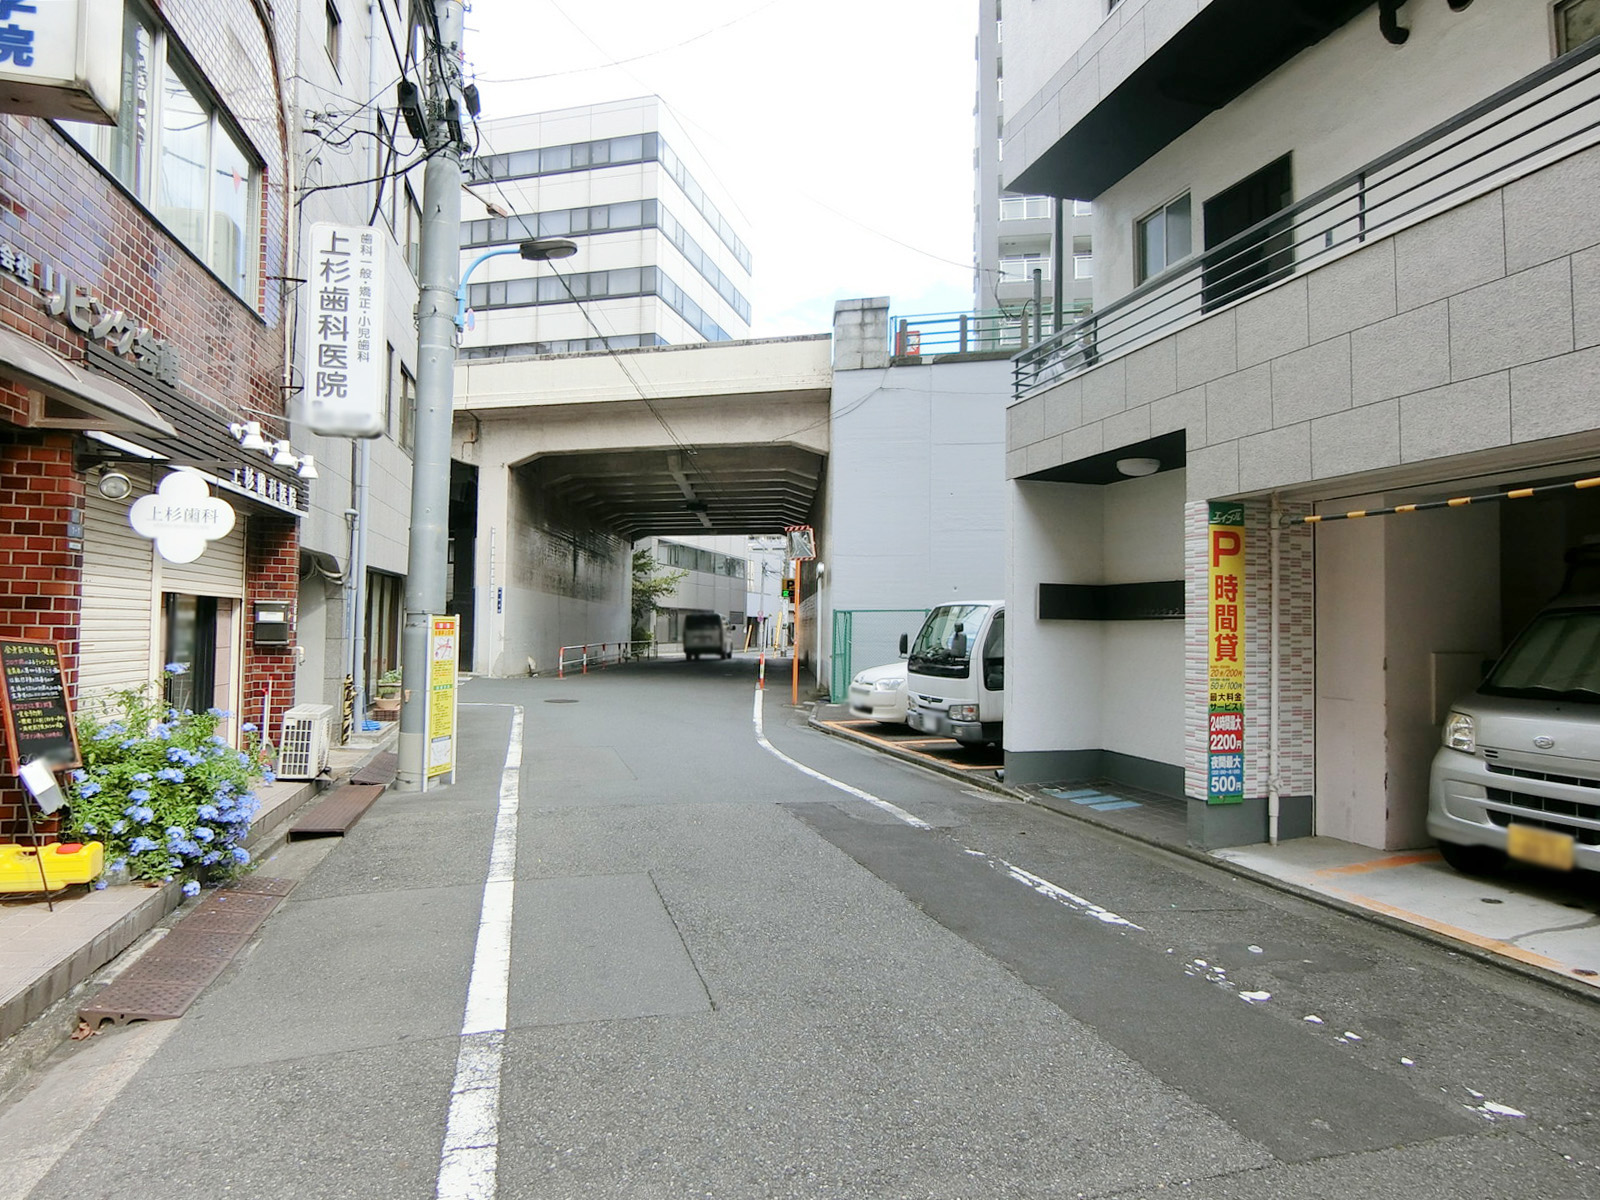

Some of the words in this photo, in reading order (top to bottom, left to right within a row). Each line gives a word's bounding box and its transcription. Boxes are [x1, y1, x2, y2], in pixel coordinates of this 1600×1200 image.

[315, 231, 351, 398] 上杉歯科医院
[230, 466, 297, 509] 上杉歯科医院
[146, 506, 219, 524] 上杉歯科
[1213, 531, 1241, 567] P
[1214, 574, 1239, 662] 時間貸
[1210, 692, 1242, 702] 最大料金
[1210, 715, 1242, 731] 24時間最大
[1210, 734, 1242, 750] 2200円
[1210, 755, 1241, 769] 夜間最大
[1210, 775, 1242, 793] 500円
